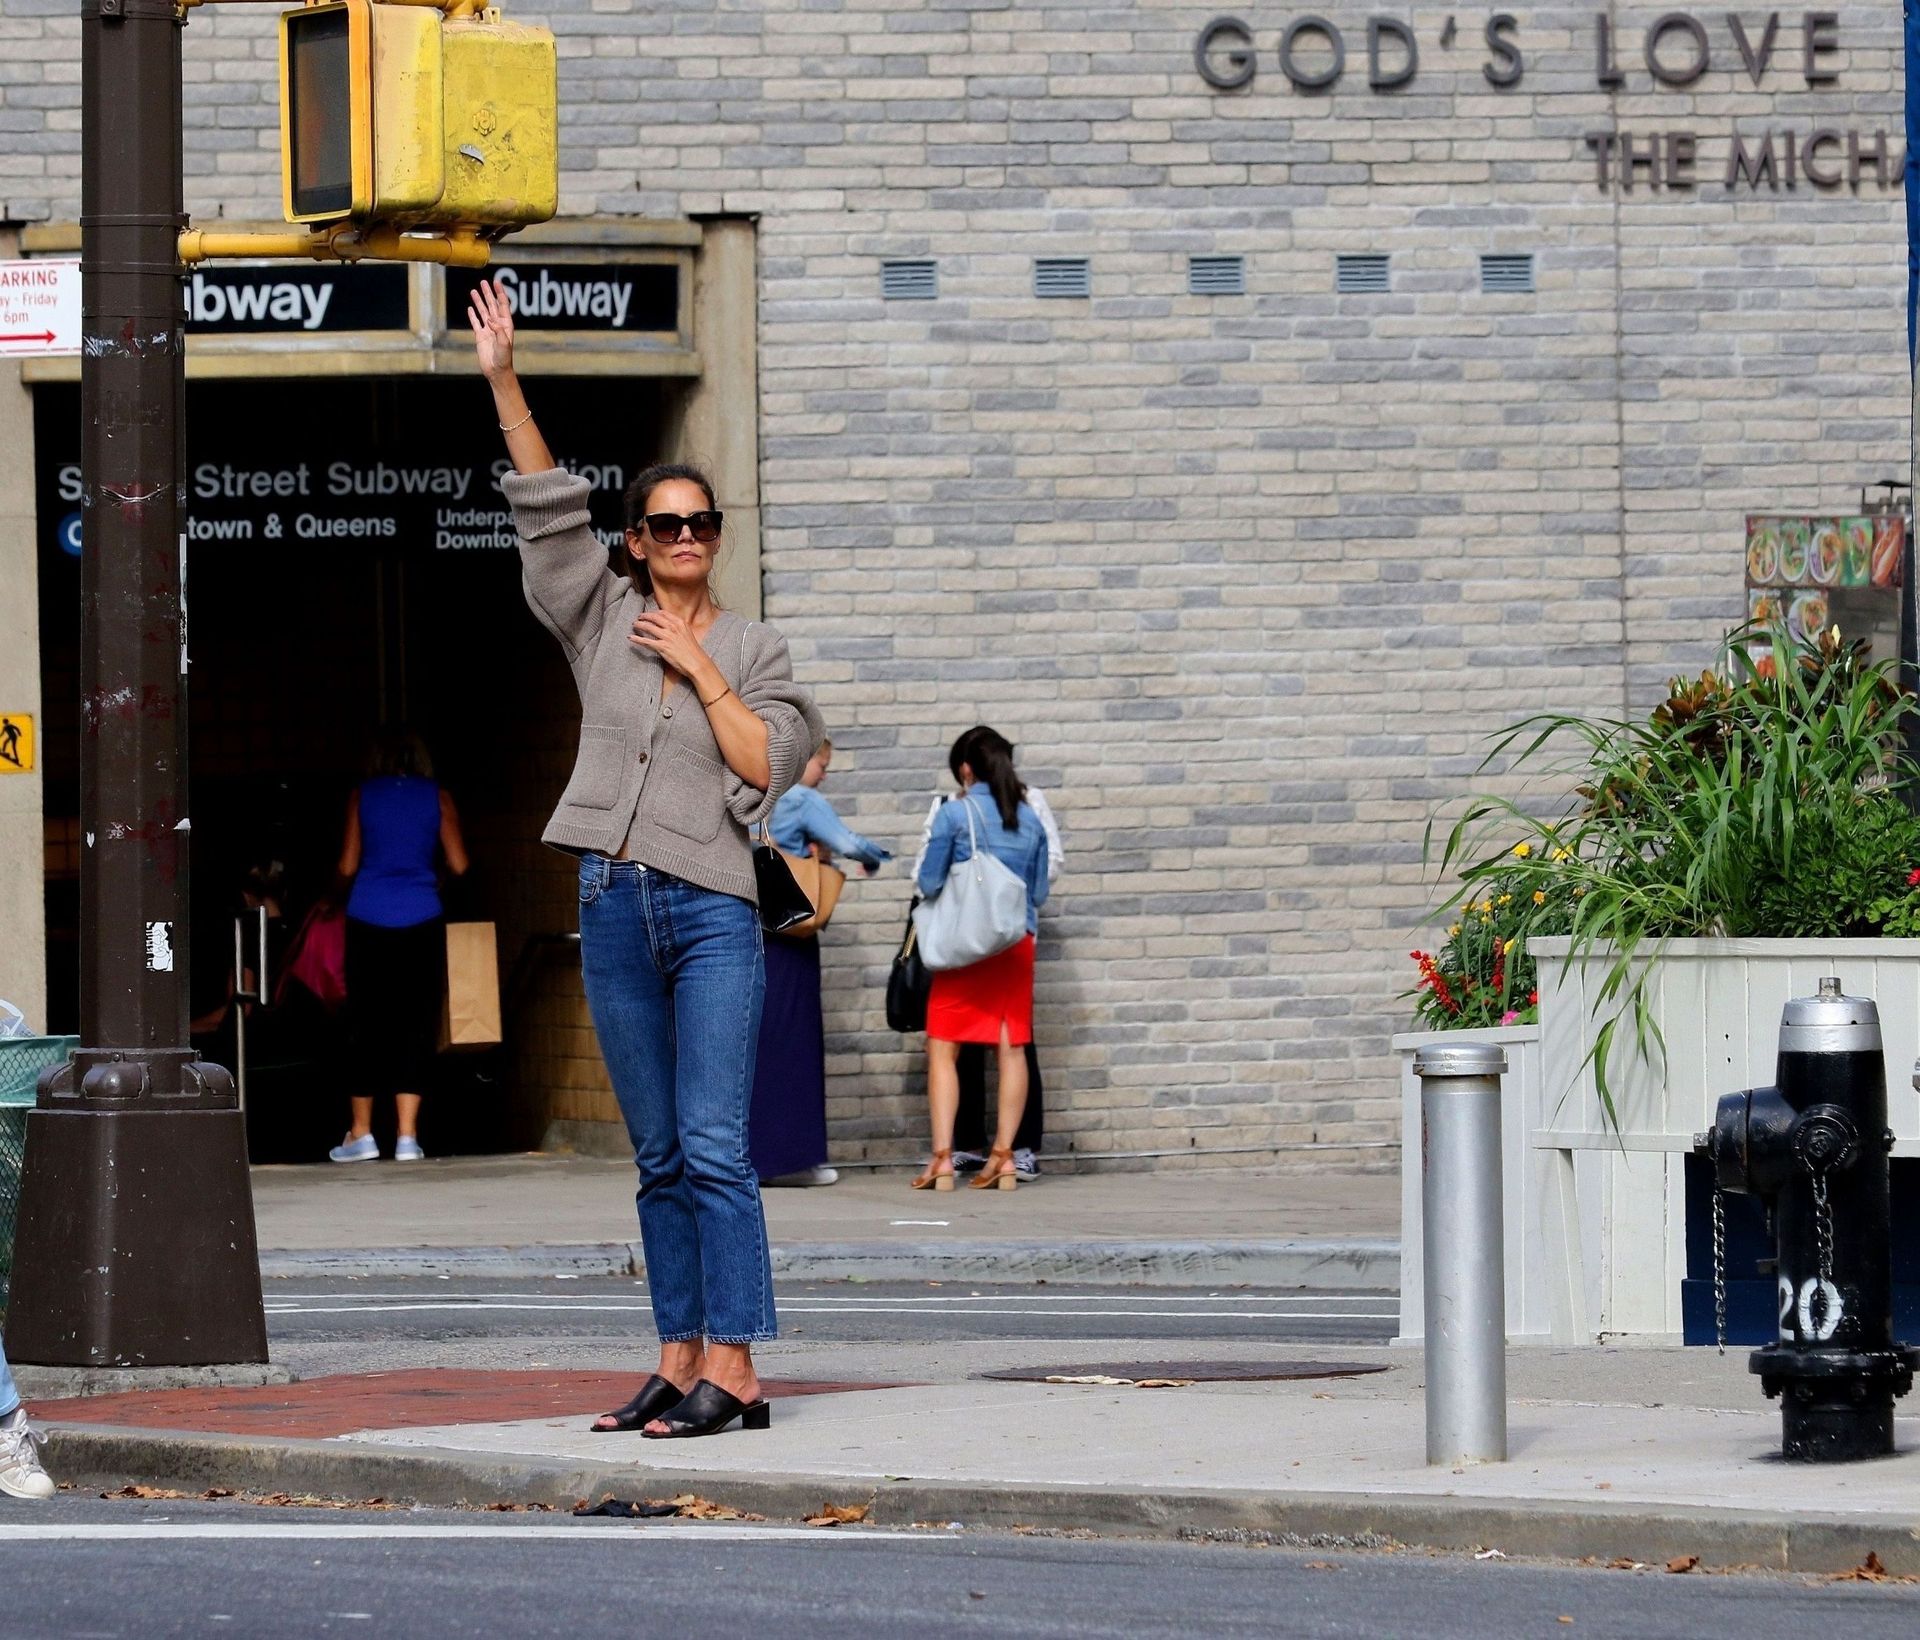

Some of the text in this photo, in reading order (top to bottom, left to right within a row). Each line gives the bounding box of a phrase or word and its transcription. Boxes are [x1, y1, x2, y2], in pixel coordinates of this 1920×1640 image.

[1194, 12, 1839, 89] GOD'S LOVE
[1586, 127, 1905, 193] THE MICH
[0, 270, 58, 287] ARKING
[22, 291, 57, 307] Friday
[184, 273, 334, 330] bway
[493, 267, 633, 327] Subway
[194, 462, 311, 498] Street
[327, 461, 472, 500] Subway
[186, 515, 253, 540] town
[263, 512, 283, 539] &
[295, 512, 397, 539] Queens
[436, 508, 515, 531] Underpa
[436, 530, 520, 550] Downto
